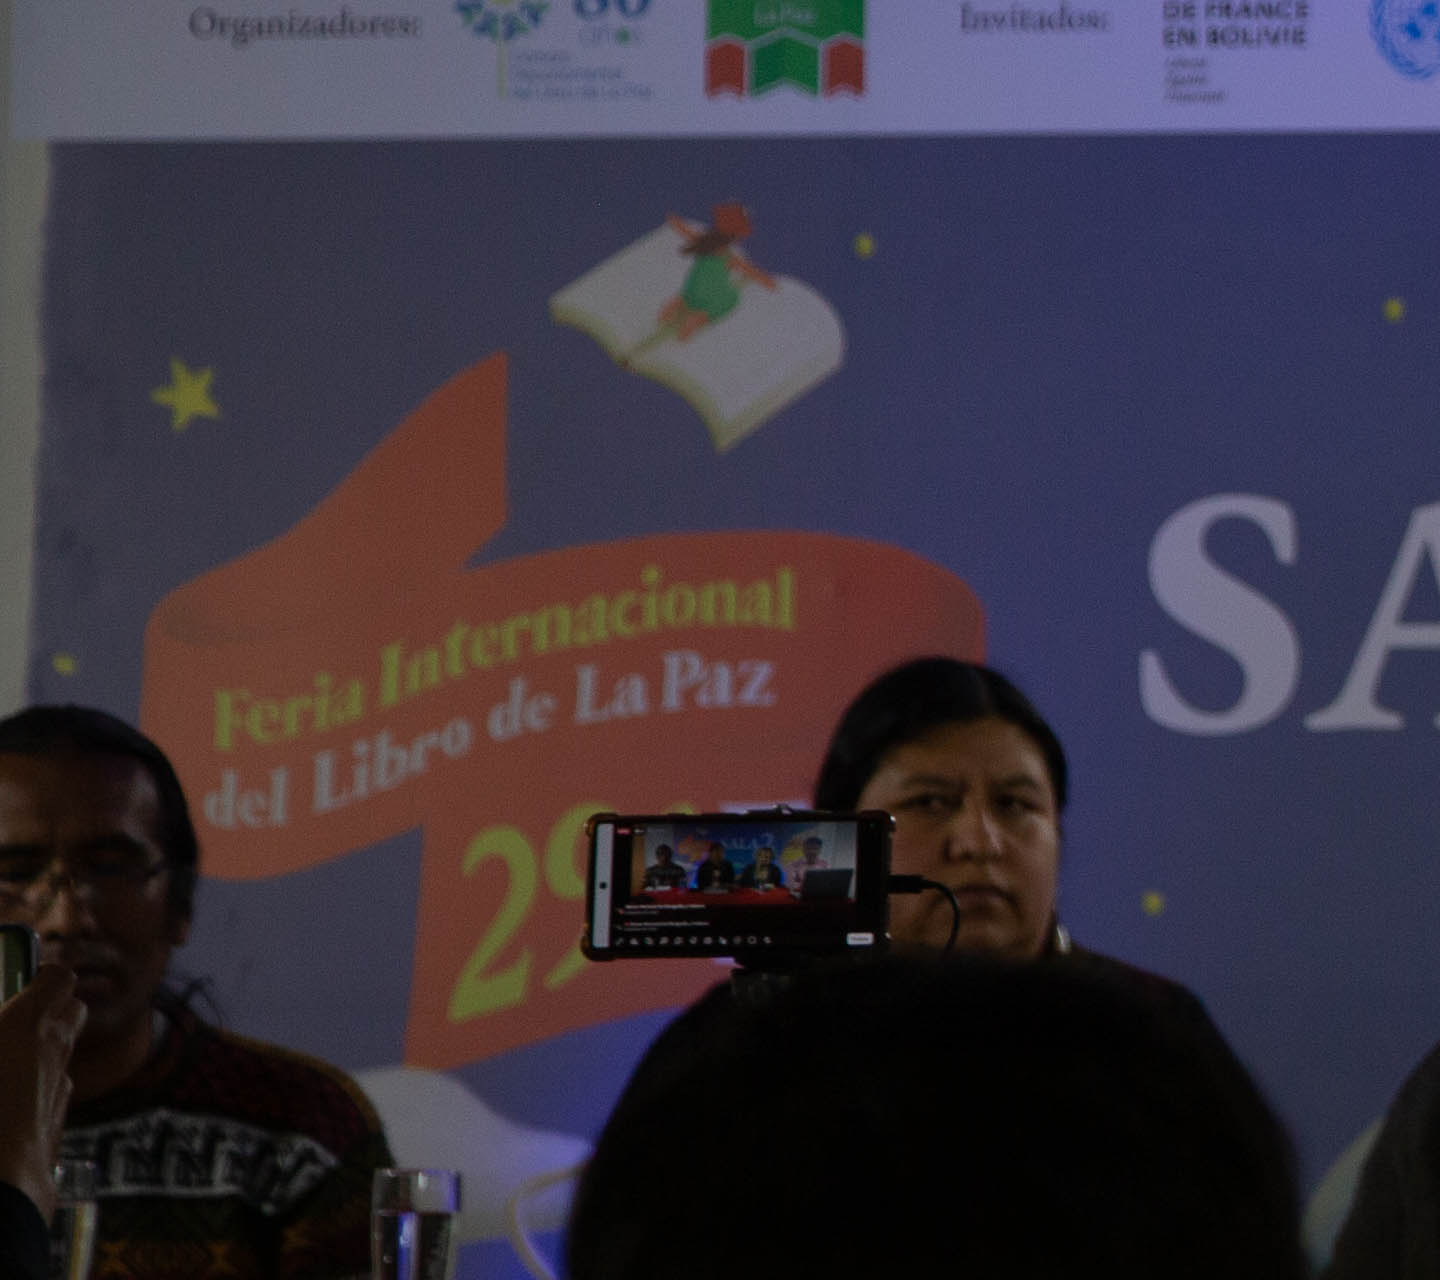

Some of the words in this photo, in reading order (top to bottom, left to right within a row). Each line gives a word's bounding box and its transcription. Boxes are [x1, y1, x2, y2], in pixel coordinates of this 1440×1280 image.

[188, 6, 420, 49] Organizadores:
[960, 0, 1110, 35] Invitados:
[1163, 0, 1196, 21] DE
[1204, 0, 1310, 21] FRANCE
[1163, 26, 1197, 48] EN
[1206, 26, 1307, 48] BOLIVIE
[212, 673, 365, 752] Feria
[379, 565, 796, 708] Internacional
[203, 771, 288, 829] del
[311, 717, 470, 815] Libro
[488, 678, 557, 741] de
[575, 662, 647, 722] La
[660, 650, 778, 711] Paz
